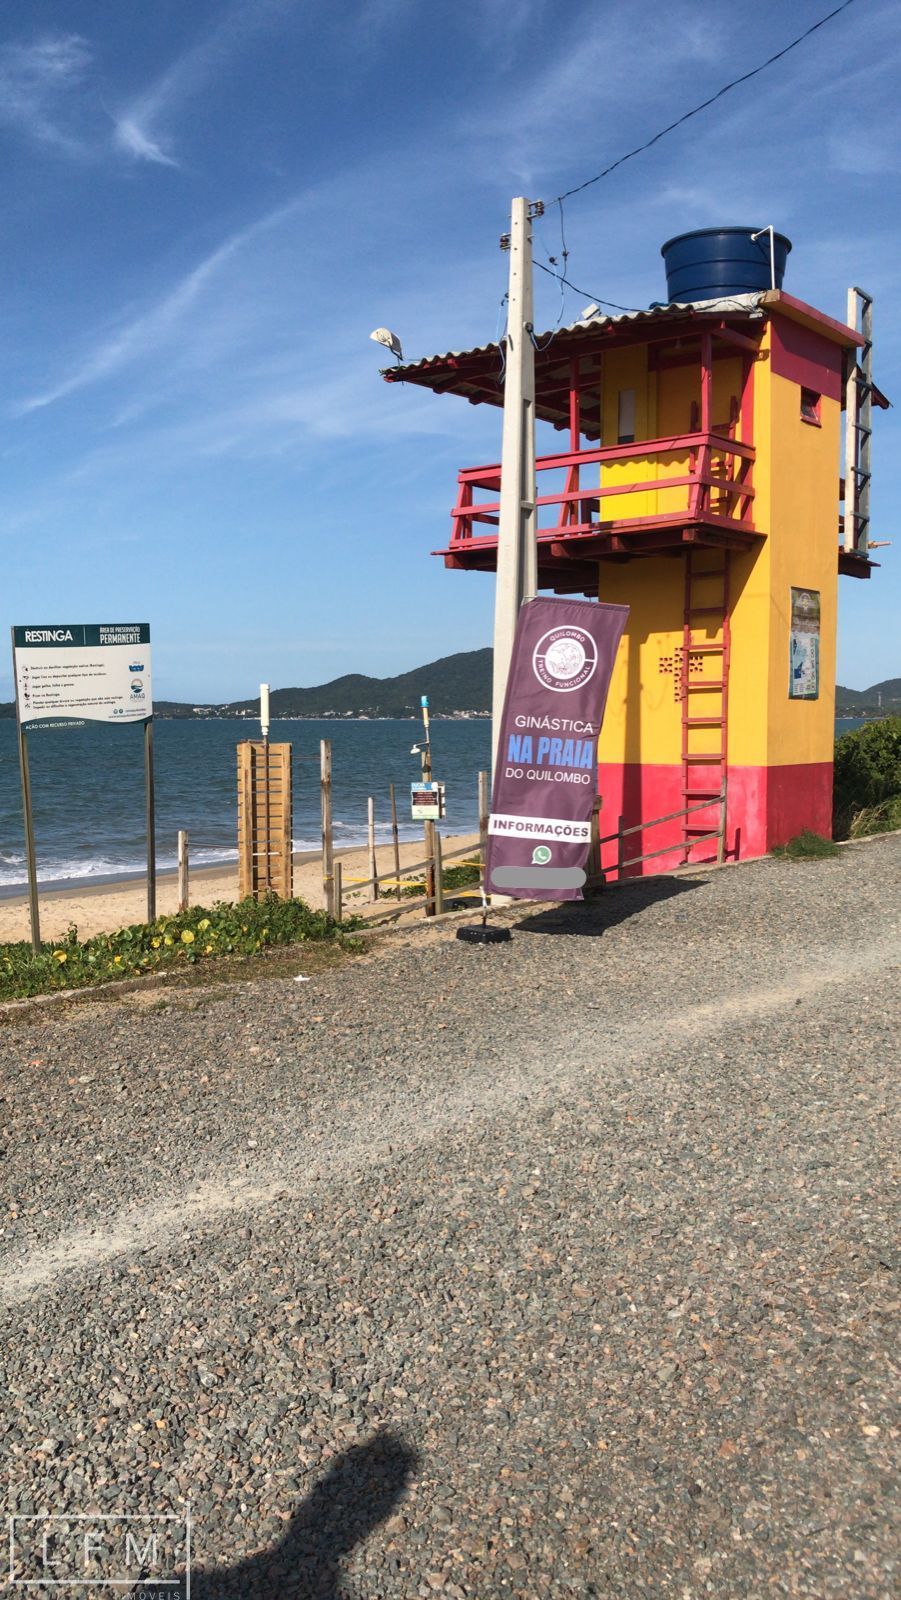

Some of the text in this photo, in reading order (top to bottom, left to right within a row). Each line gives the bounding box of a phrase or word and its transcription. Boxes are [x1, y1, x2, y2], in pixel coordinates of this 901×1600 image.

[25, 630, 73, 642] RESTINGA
[100, 633, 141, 644] PERMANENTE
[549, 631, 585, 642] QUILOMBO
[537, 659, 591, 687] TREINO FUNCIONAL
[515, 715, 593, 734] GINÁSTICA
[507, 734, 594, 769] NA PRAIA
[505, 767, 590, 785] DO QUILOMBO
[493, 819, 589, 837] INFORMAÇÕES
